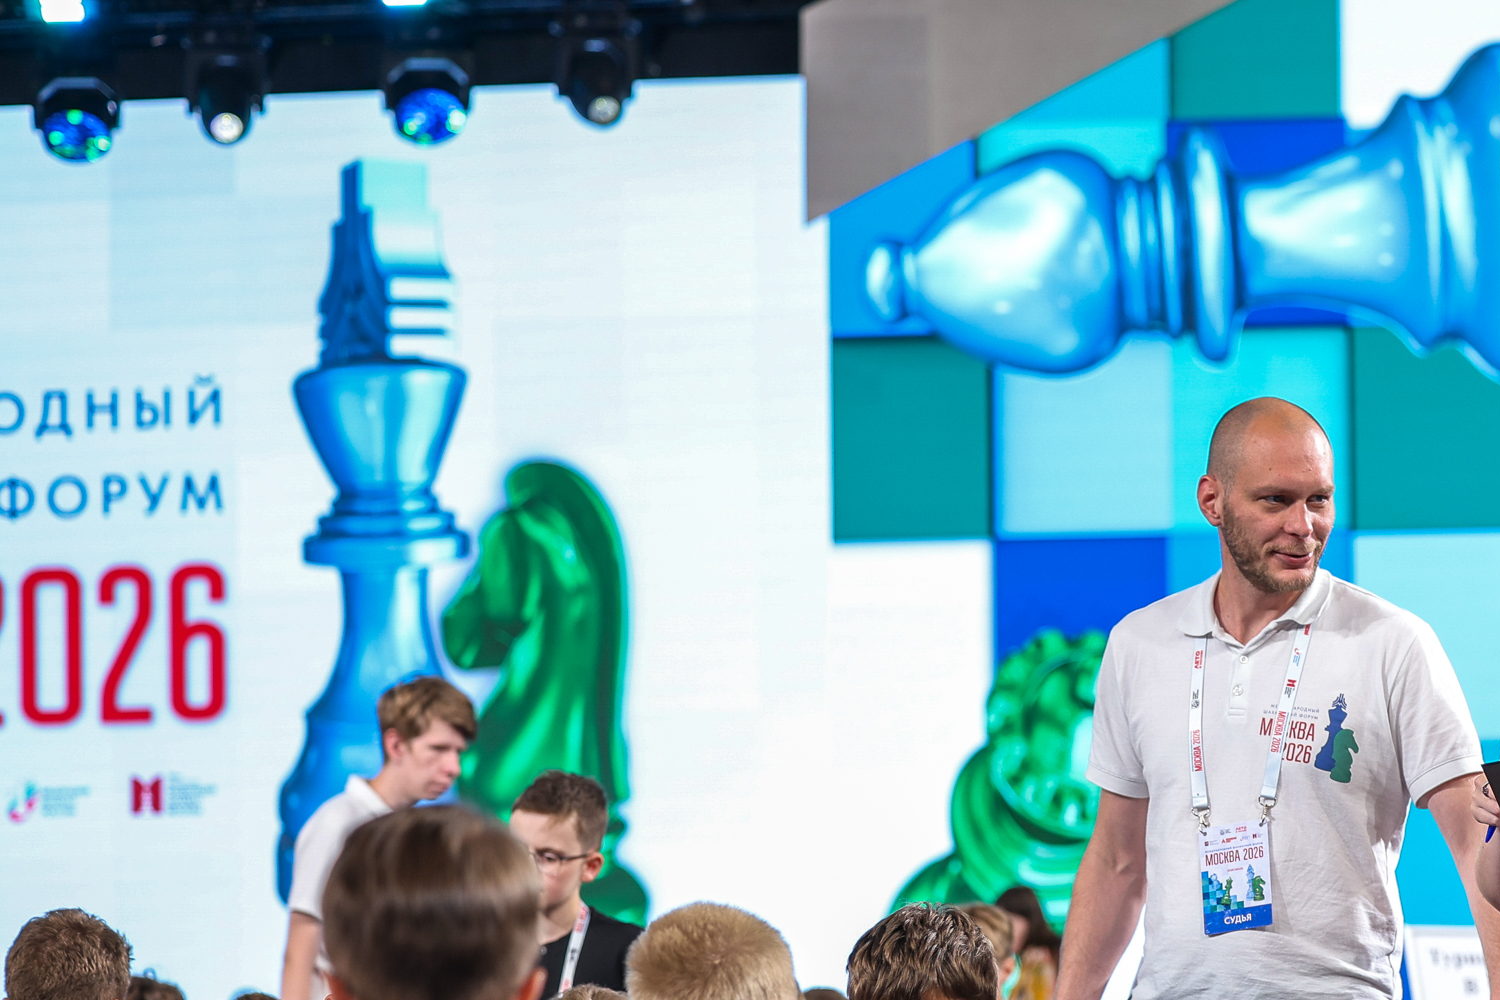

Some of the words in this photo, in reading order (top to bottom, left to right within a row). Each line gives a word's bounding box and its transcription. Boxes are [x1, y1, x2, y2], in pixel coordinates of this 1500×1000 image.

[0, 473, 224, 519] ФОРУМ
[0, 564, 227, 725] 026
[1270, 703, 1320, 714] МЕАРОДНЫЙ
[1259, 717, 1315, 742] МКВА
[1273, 710, 1287, 736] МОСКВА
[1205, 849, 1241, 867] МОСКВА
[1242, 845, 1264, 861] 2026
[1223, 913, 1252, 925] СУДЬЯ
